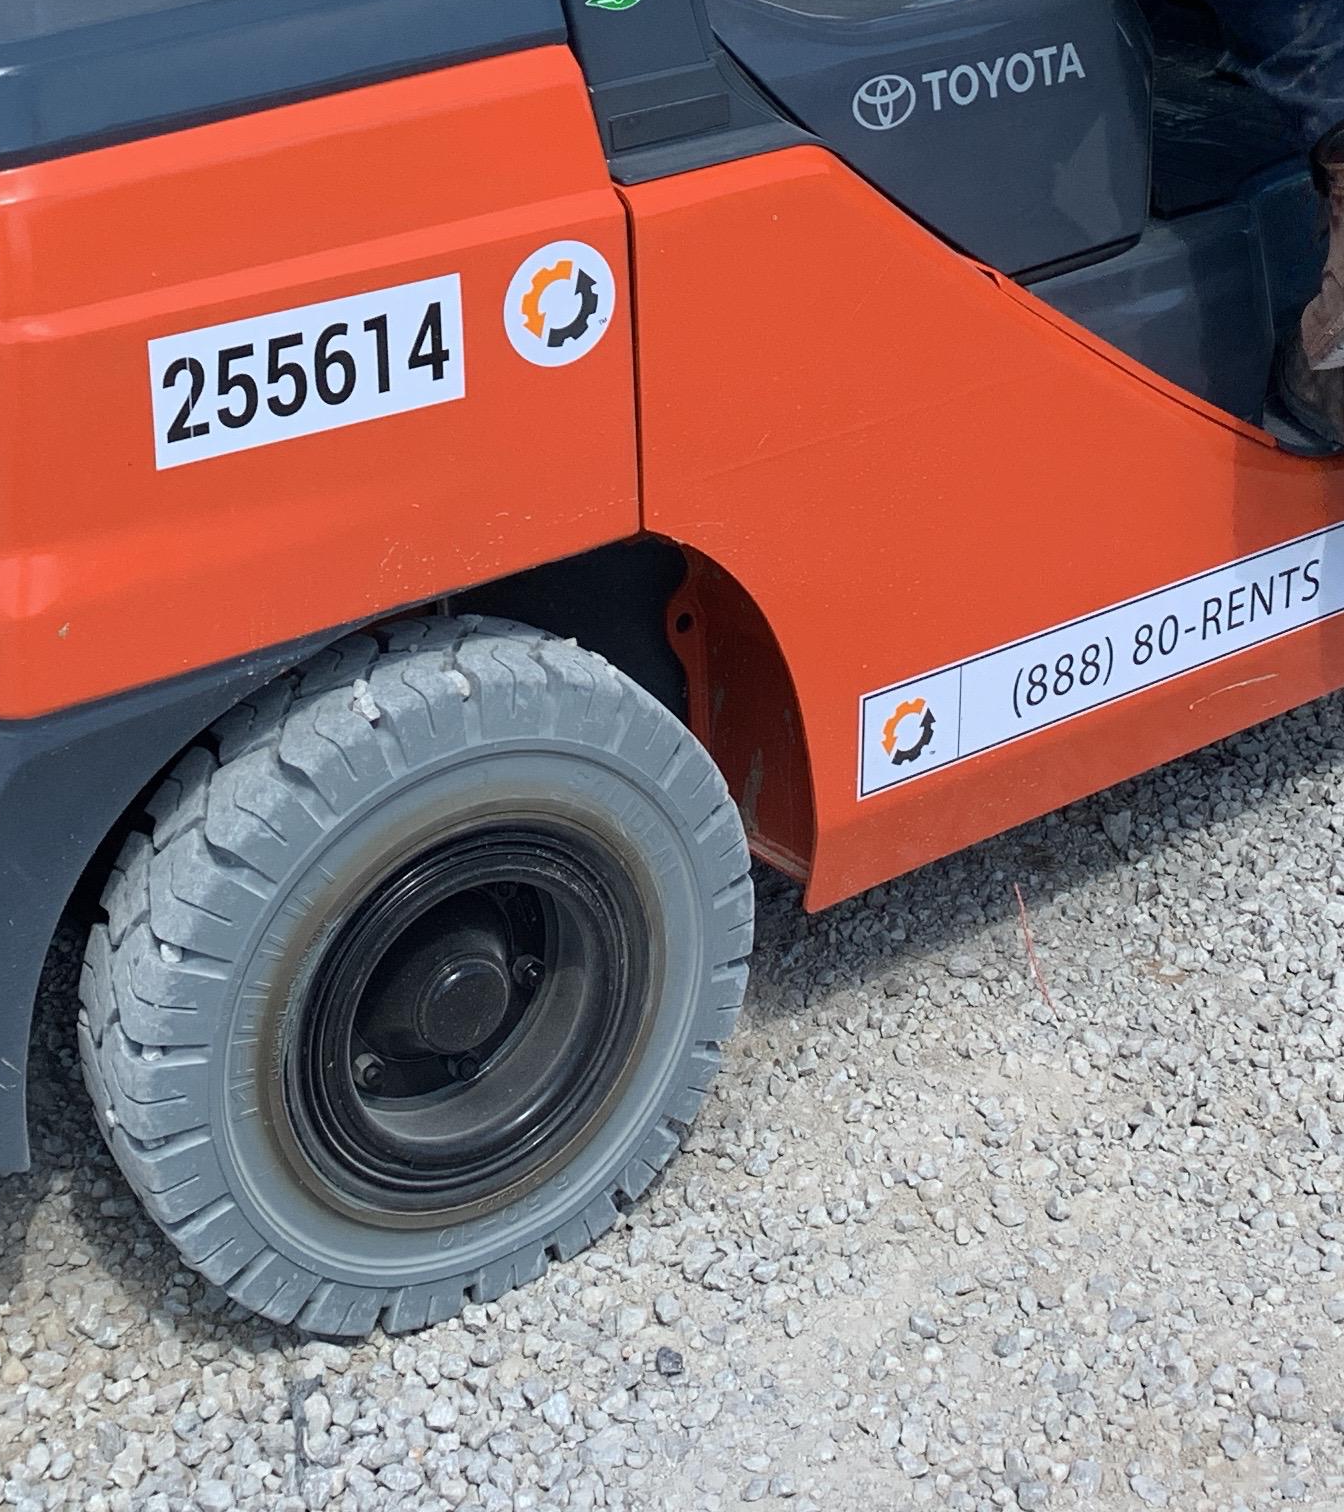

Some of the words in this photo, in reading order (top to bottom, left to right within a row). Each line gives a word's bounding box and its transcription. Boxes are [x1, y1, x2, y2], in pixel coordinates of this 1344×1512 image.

[921, 42, 1087, 112] TOYOTA
[161, 301, 451, 445] 255614
[1010, 636, 1114, 719] (888)
[1132, 559, 1321, 666] 80-RENTS
